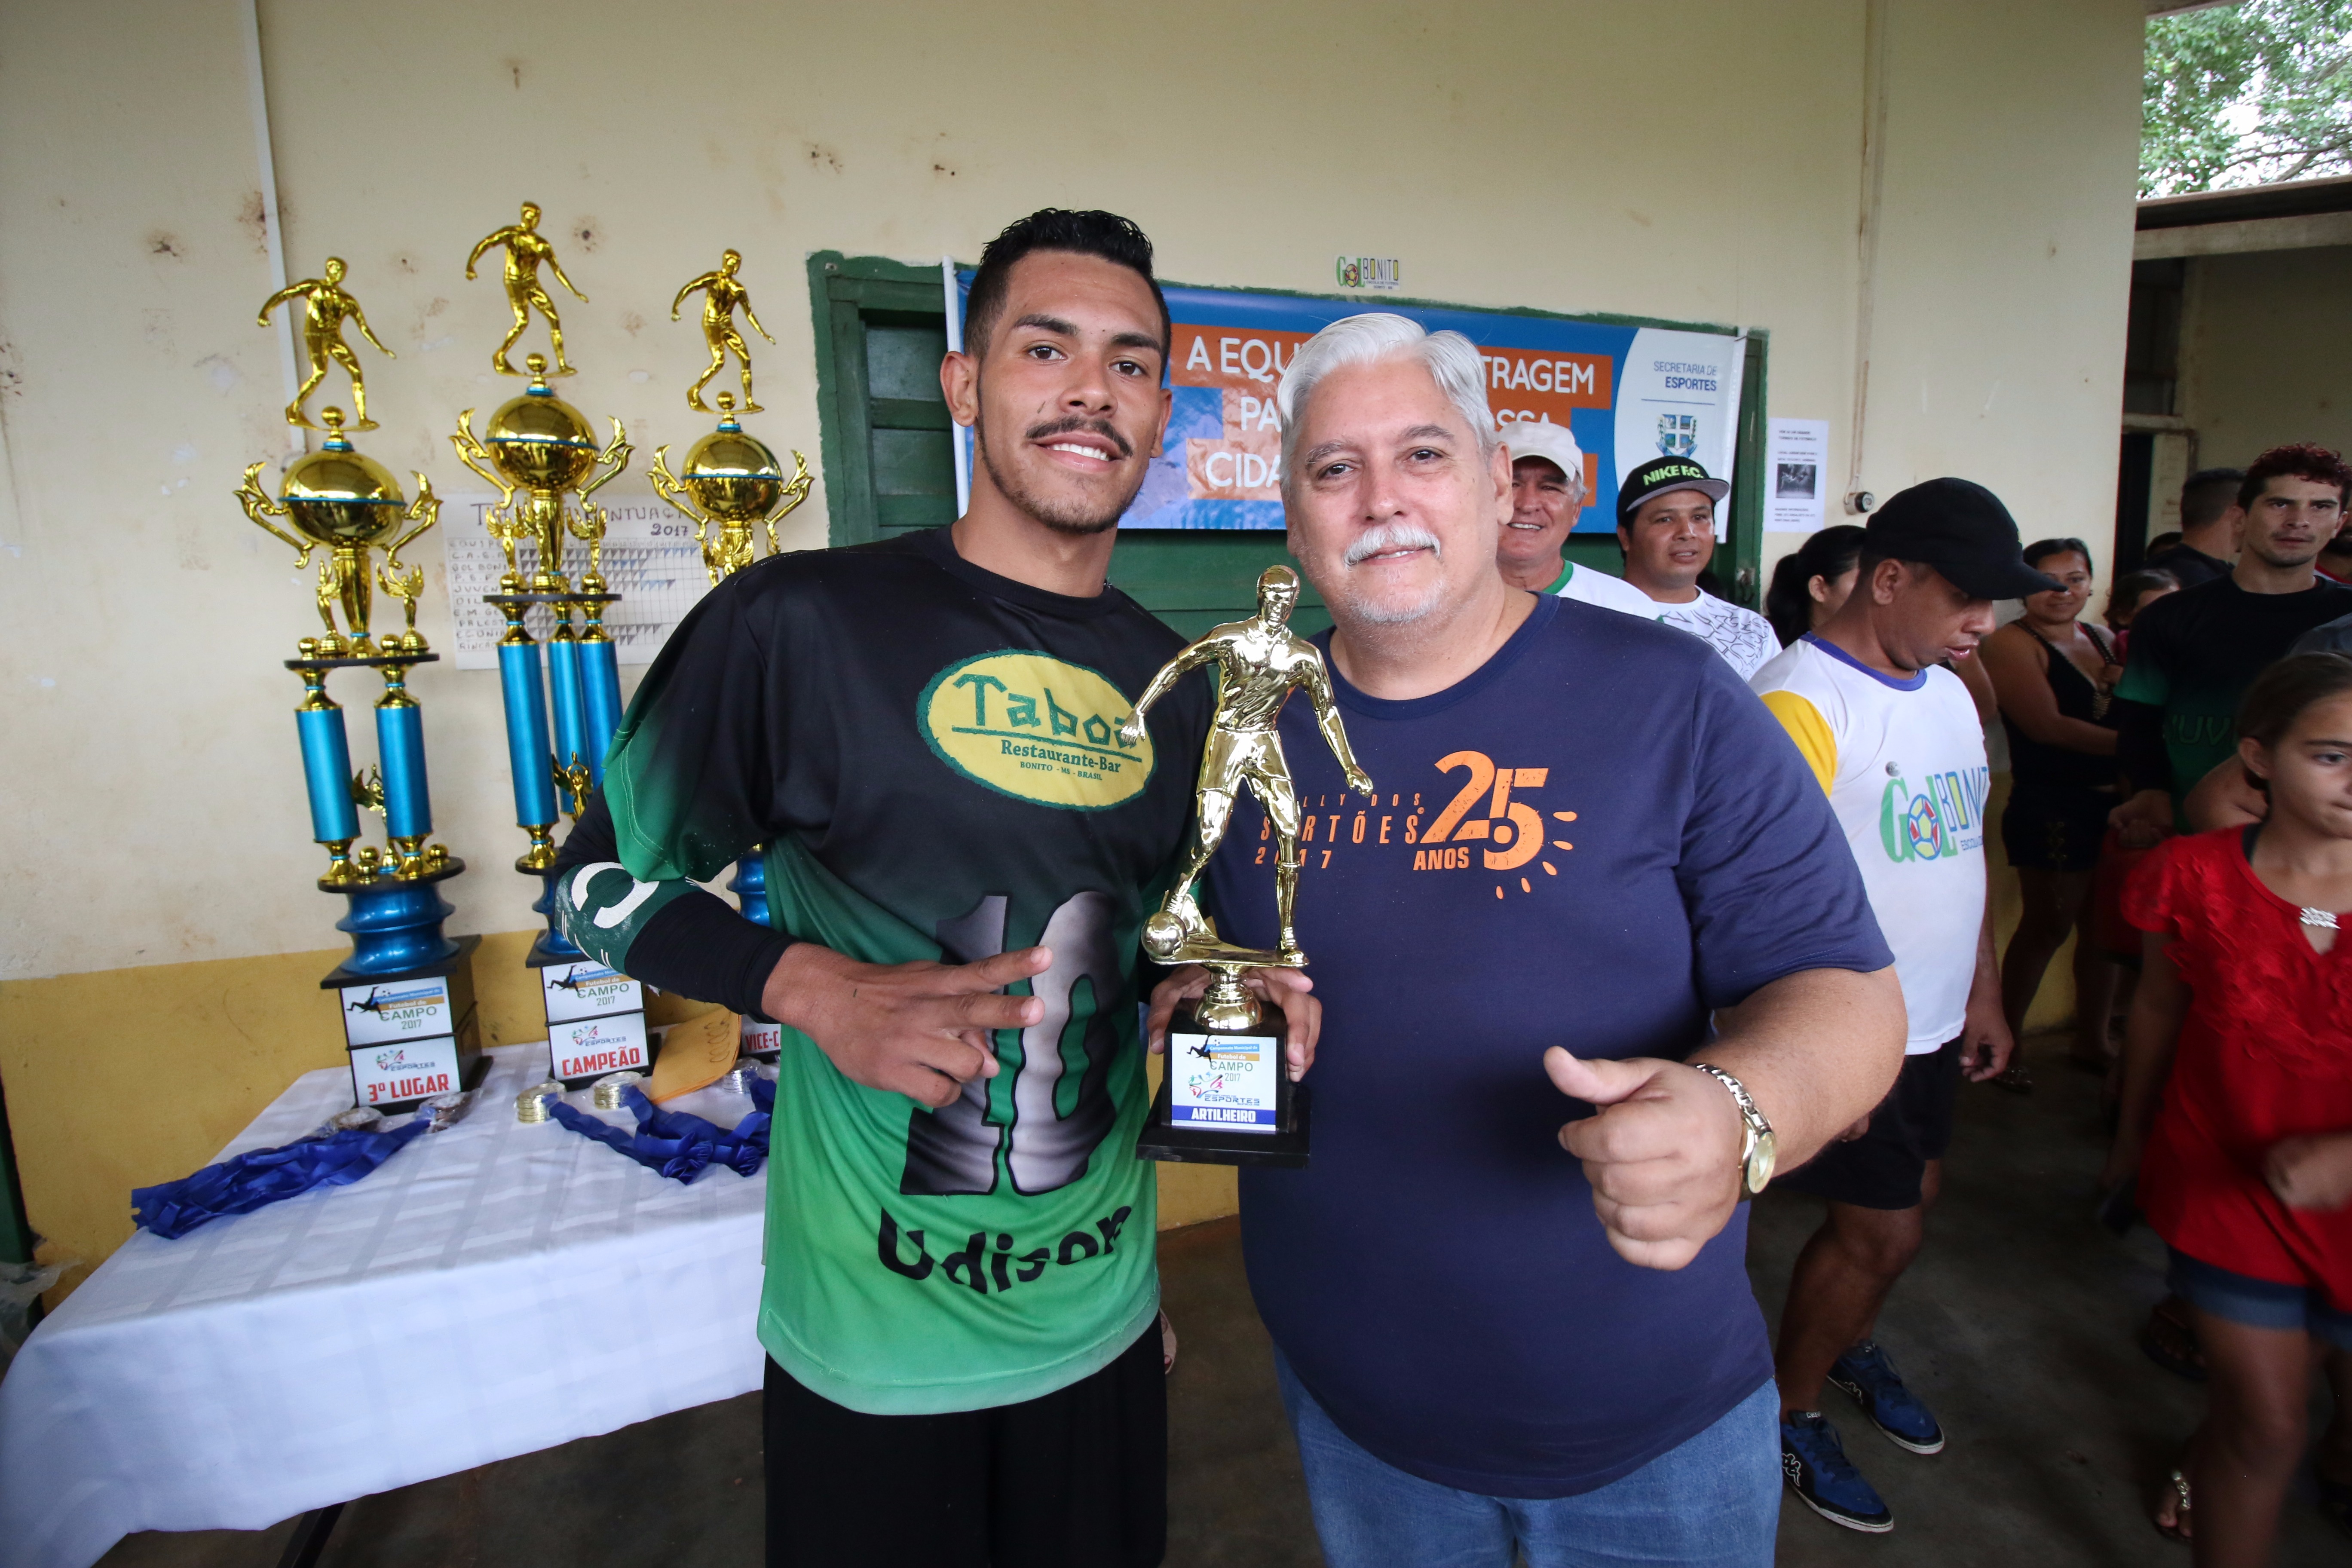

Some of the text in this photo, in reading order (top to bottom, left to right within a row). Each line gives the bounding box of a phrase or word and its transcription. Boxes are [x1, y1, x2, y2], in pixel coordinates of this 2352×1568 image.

[1363, 258, 1398, 281] BONITO
[1186, 336, 1595, 395] A EQU RAGEM
[1654, 361, 1718, 376] SECRETARIA DE
[1666, 377, 1717, 391] ESPORTES
[1241, 396, 1282, 432] PA
[1205, 452, 1281, 488] CIDA
[1643, 465, 1704, 486] NIKE F.C.
[651, 523, 689, 536] 2017
[478, 563, 507, 571] BONI
[454, 585, 499, 593] JUVEN
[1001, 739, 1121, 773] Restaurante-Bar
[1020, 761, 1053, 771] BONITO
[1077, 770, 1102, 781] BRASIL
[1371, 793, 1420, 807] DOS
[1934, 766, 1988, 832] BONIT
[1260, 811, 1418, 845] SRTÕES
[1413, 847, 1470, 871] ANOS
[585, 978, 610, 986] Futebol
[577, 983, 629, 998] CAMPO
[596, 995, 615, 1006] 2017
[380, 1006, 437, 1021] CAMPO
[401, 1019, 422, 1029] 2017
[585, 1036, 627, 1046] ESPORTES
[744, 1030, 779, 1051] VICE-C
[562, 1045, 640, 1076] CAMPEÃO
[1210, 1061, 1253, 1072] CAMPO
[1225, 1073, 1240, 1081] 2017
[390, 1073, 449, 1098] LUGAR
[1191, 1108, 1256, 1123] ARTILHEIRO
